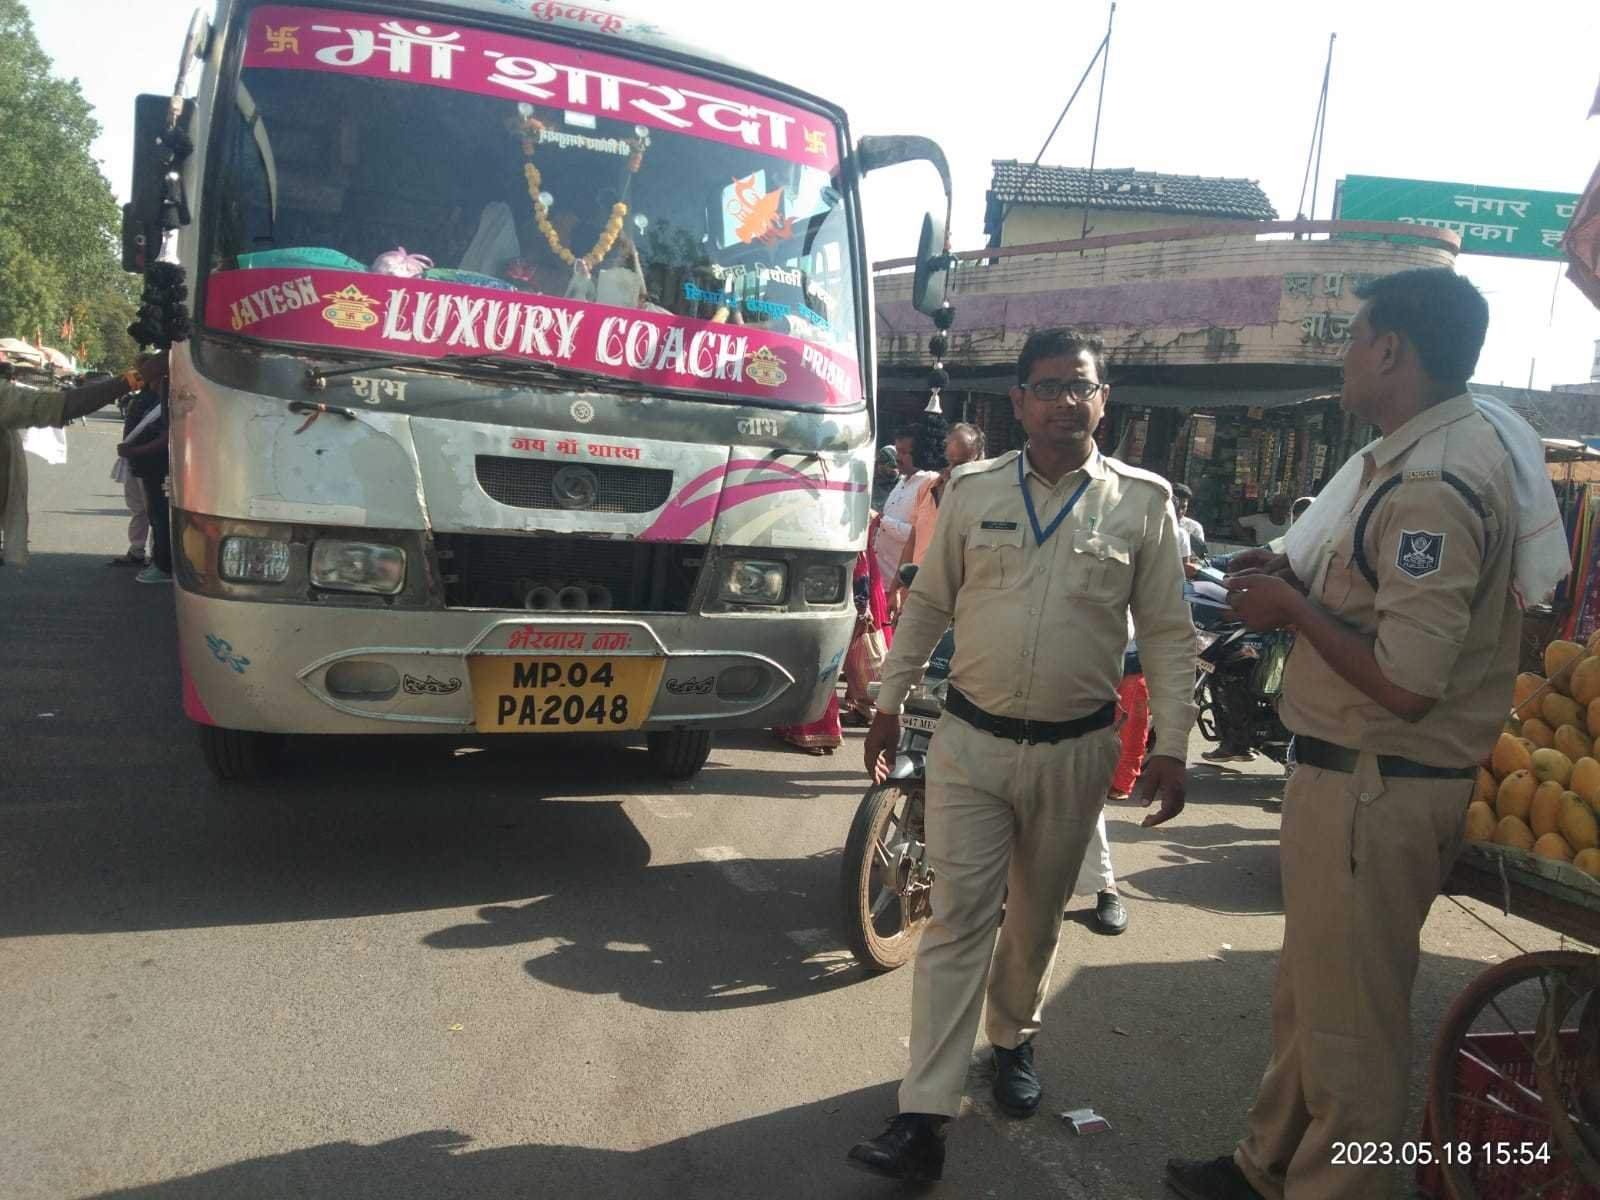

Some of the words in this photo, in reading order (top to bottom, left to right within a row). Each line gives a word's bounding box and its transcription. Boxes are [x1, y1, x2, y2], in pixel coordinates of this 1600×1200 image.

[483, 49, 797, 151] शारदा
[1454, 195, 1532, 218] नगर
[229, 275, 321, 331] JAYESH
[382, 288, 585, 360] LUXURY
[596, 315, 750, 382] COACH
[351, 375, 408, 405] शुभ
[736, 416, 779, 437] लाभ
[511, 437, 547, 452] जय
[588, 443, 642, 460] शारदा
